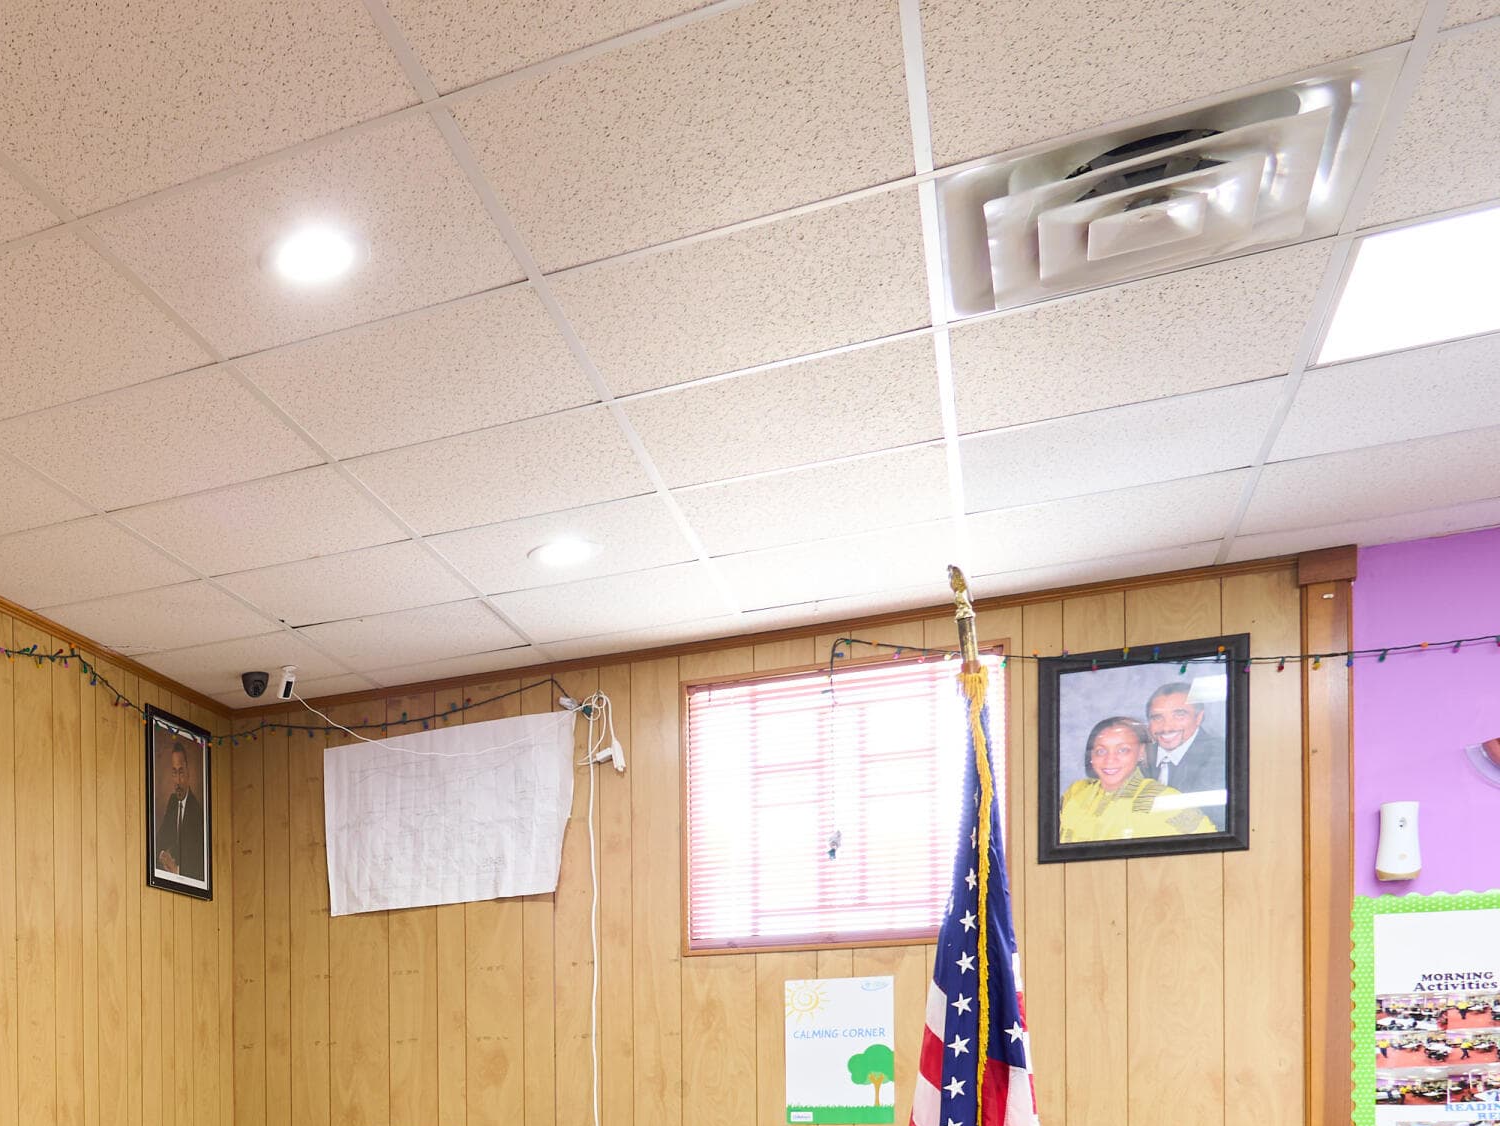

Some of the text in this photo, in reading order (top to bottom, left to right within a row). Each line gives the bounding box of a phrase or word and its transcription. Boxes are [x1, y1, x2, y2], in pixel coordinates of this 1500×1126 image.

[1421, 971, 1494, 982] MORNING
[1413, 980, 1499, 992] Activities
[793, 1027, 885, 1039] CALMING CORNER
